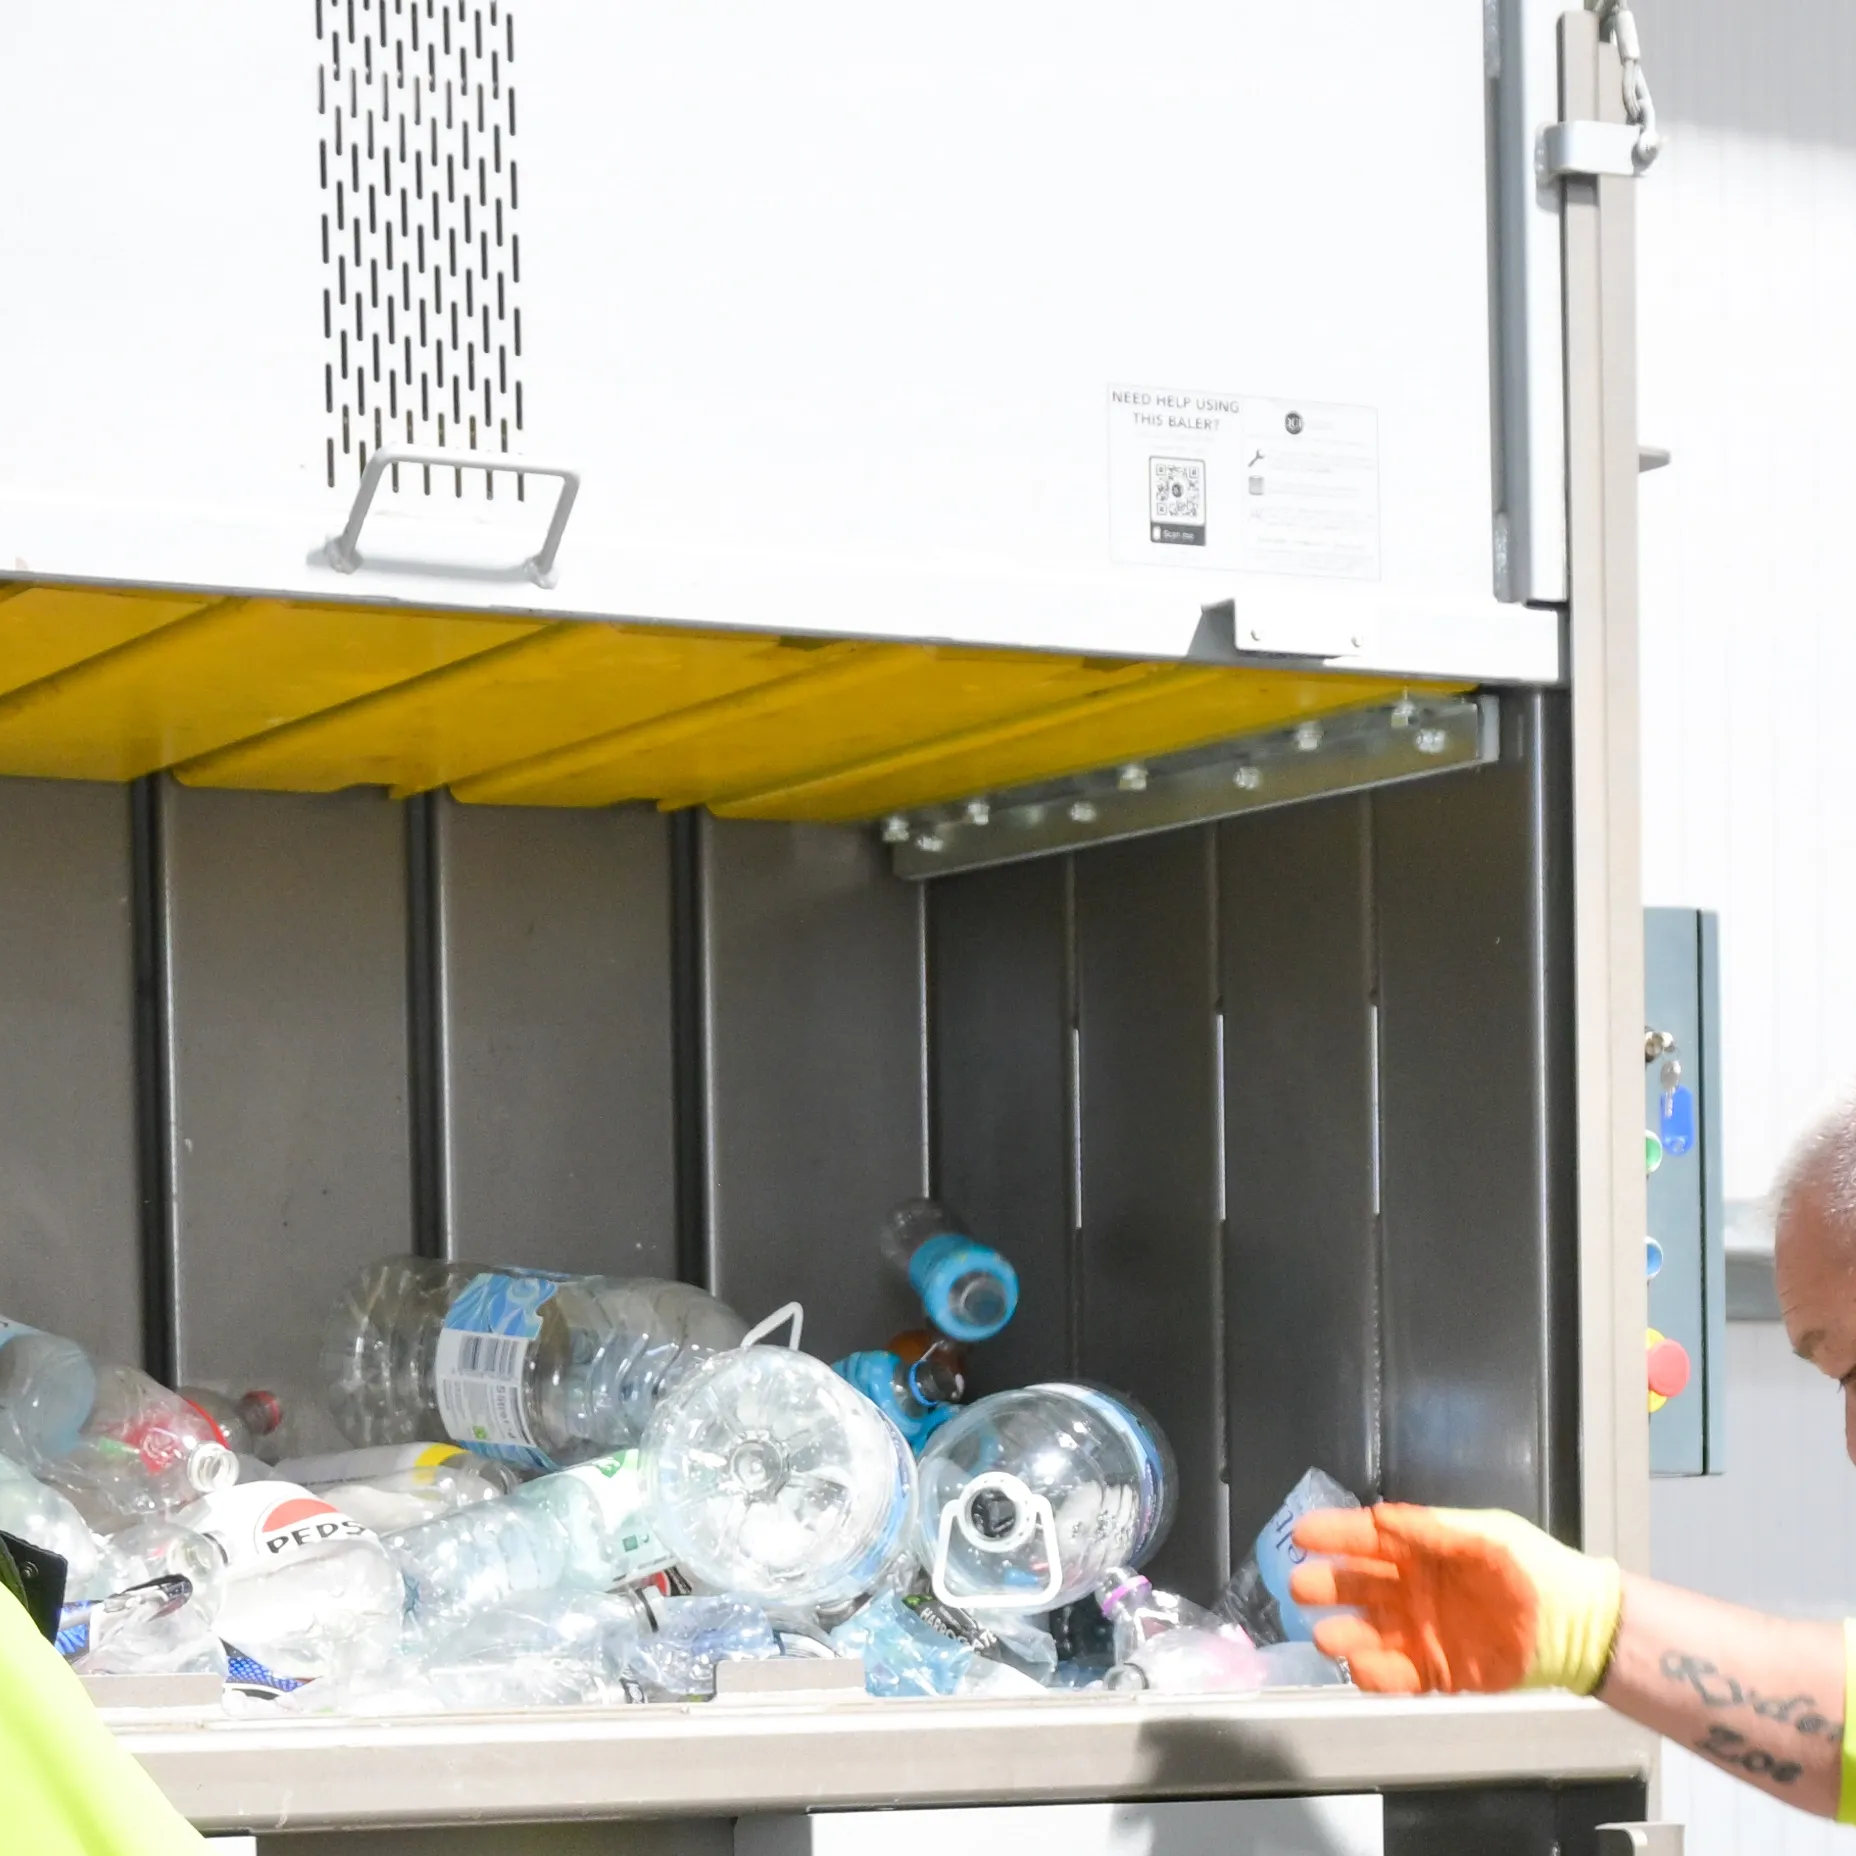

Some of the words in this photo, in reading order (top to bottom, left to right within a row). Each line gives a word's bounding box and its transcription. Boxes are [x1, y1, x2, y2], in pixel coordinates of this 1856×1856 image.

[1111, 390, 1152, 407] NEED
[1156, 394, 1191, 410] HELP
[1196, 398, 1240, 414] USING
[1133, 412, 1164, 427] THIS
[1169, 415, 1220, 431] BALER?
